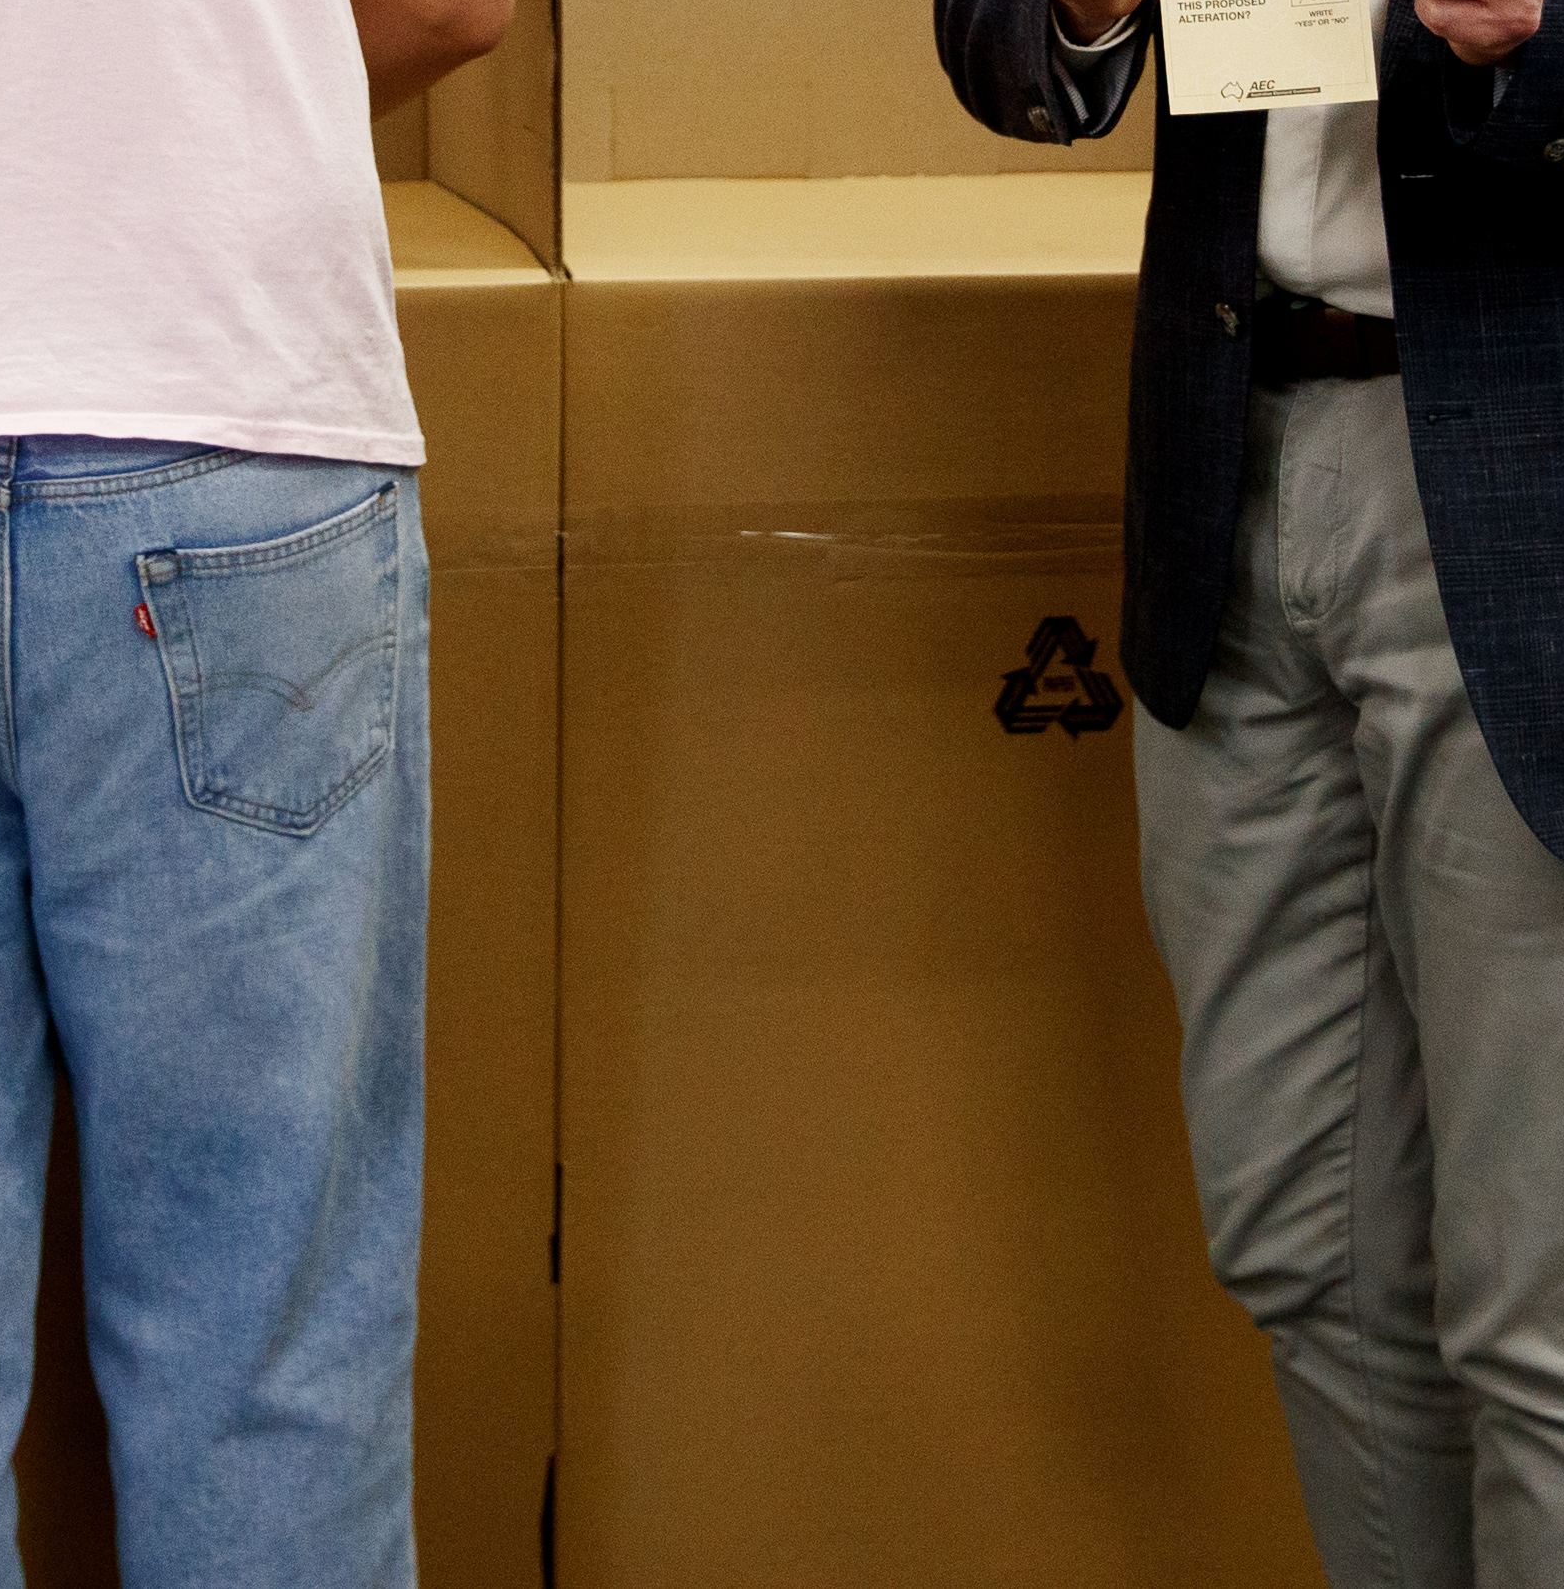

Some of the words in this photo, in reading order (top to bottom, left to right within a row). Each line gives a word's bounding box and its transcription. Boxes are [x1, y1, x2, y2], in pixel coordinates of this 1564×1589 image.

[1177, 1, 1203, 11] THIS
[1178, 10, 1251, 24] ALTERATION?
[1309, 9, 1333, 18] WRITE
[1318, 18, 1330, 26] OR
[1249, 79, 1276, 91] AEC
